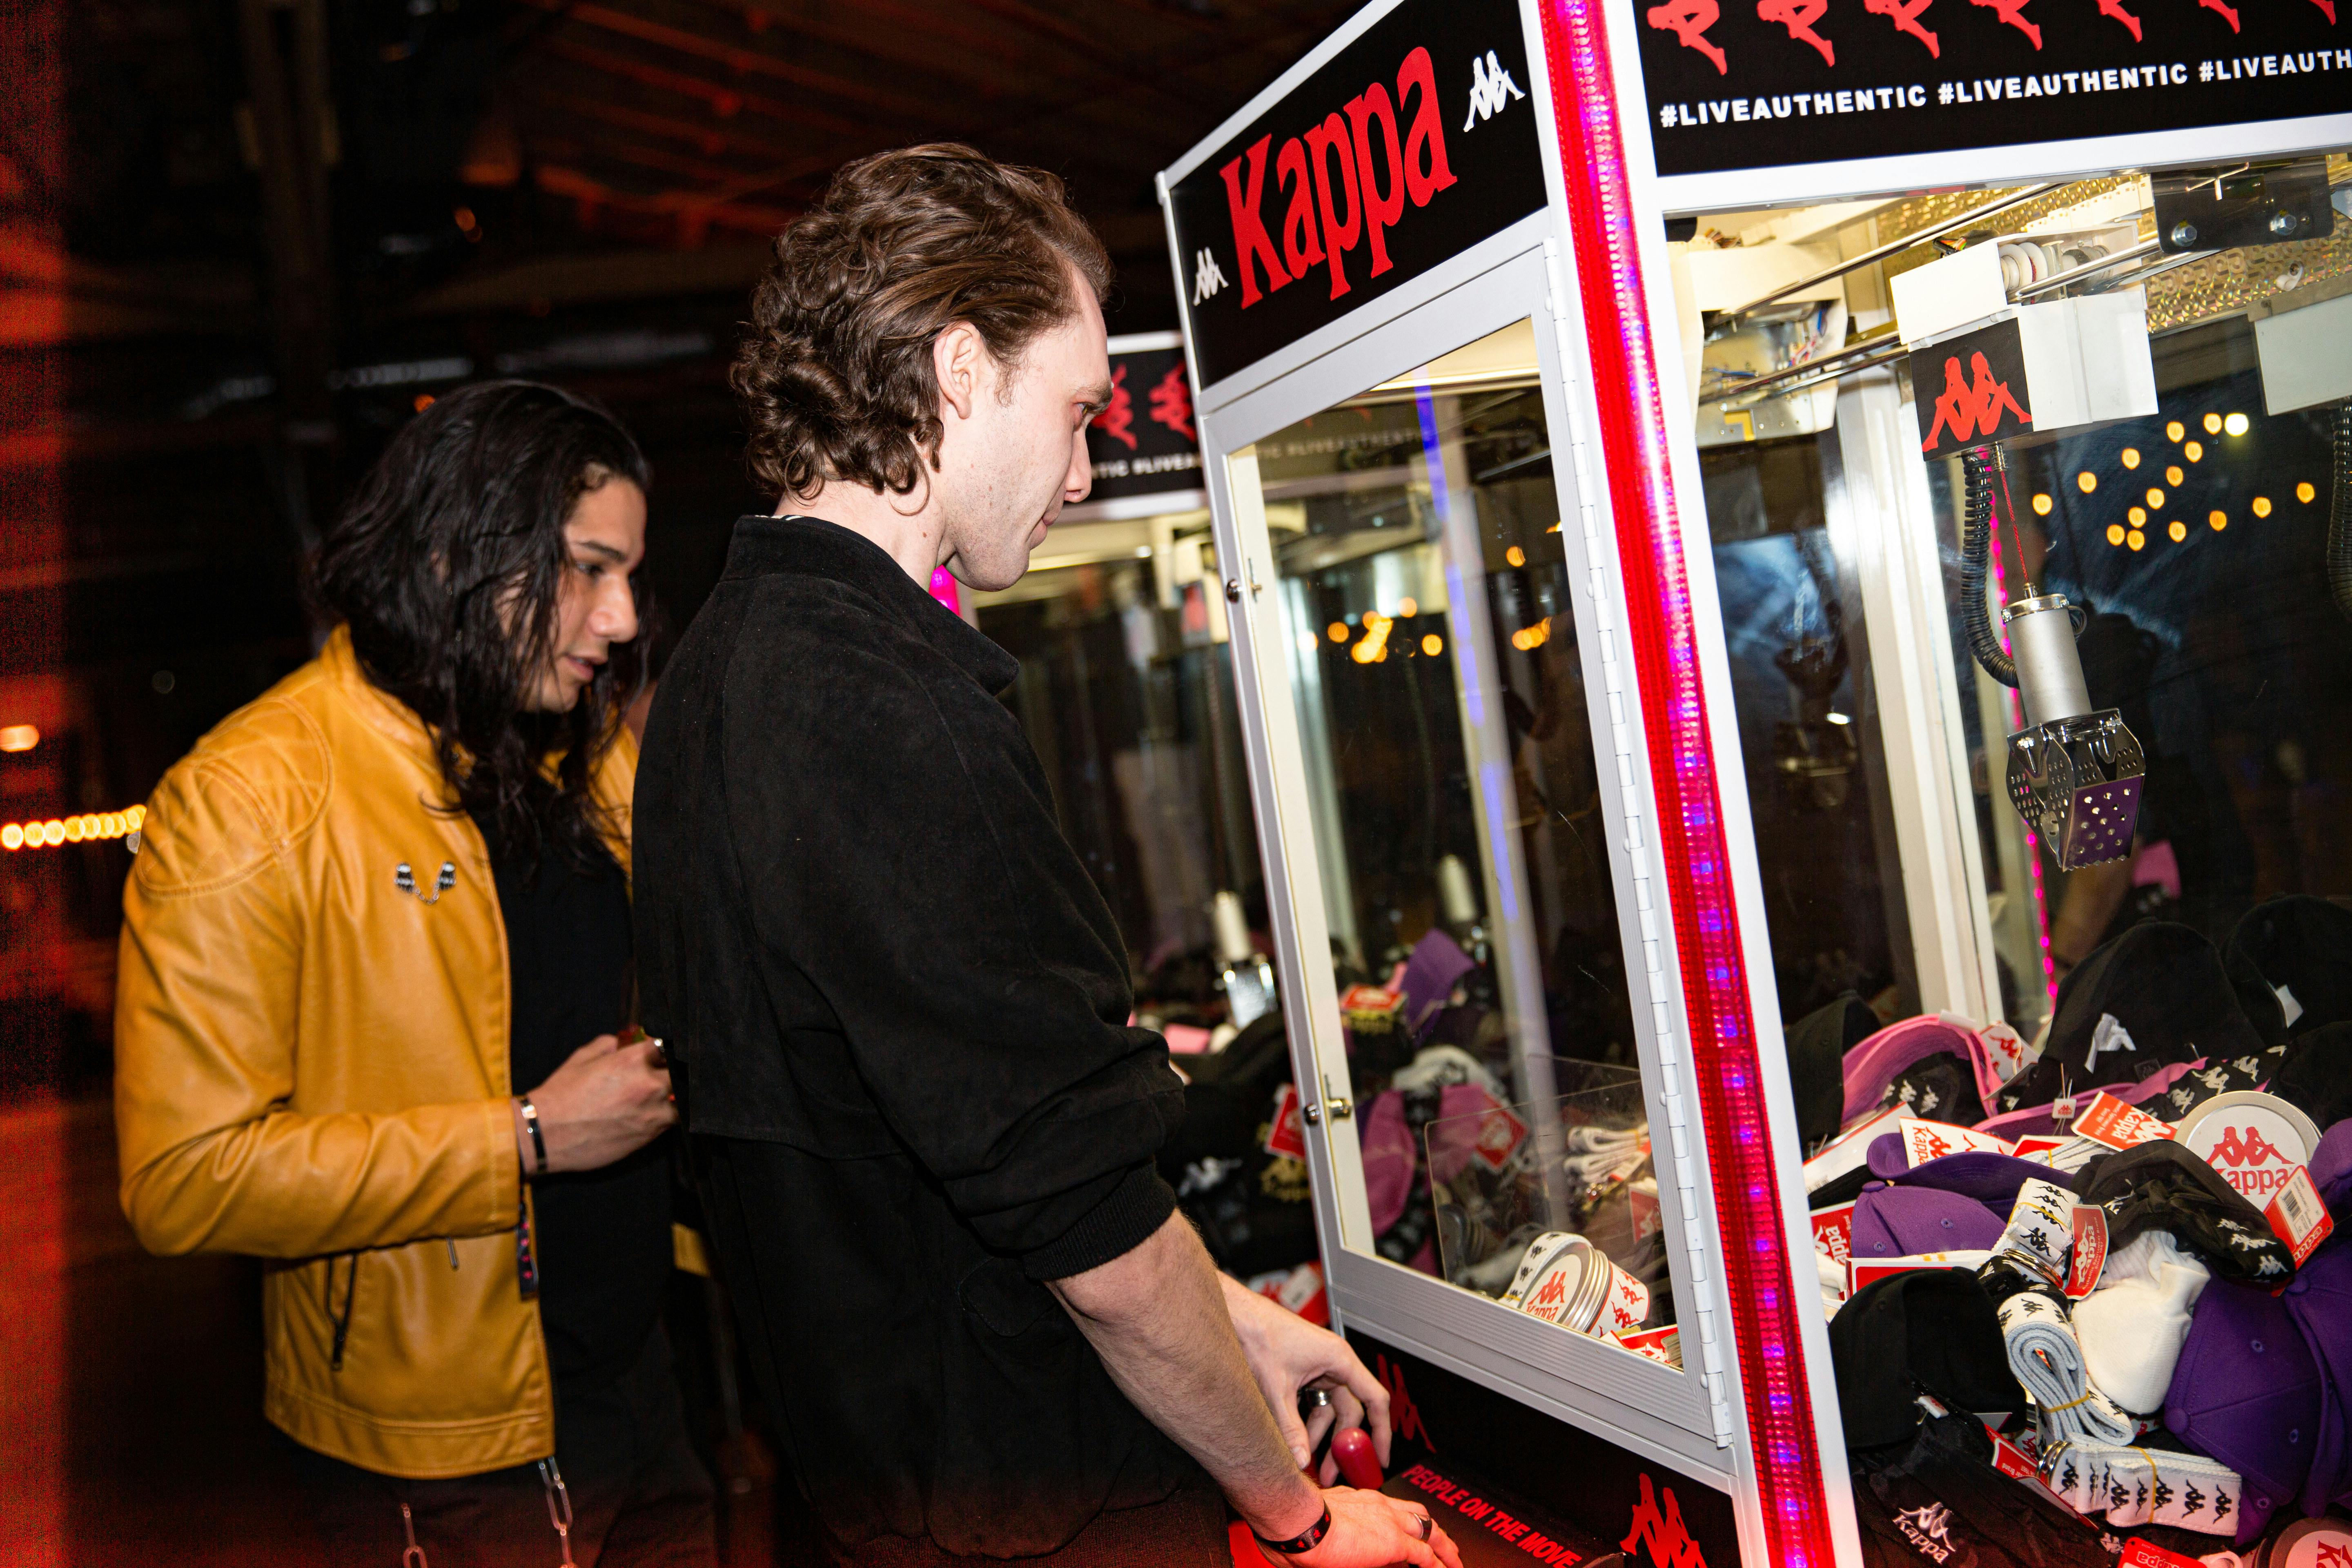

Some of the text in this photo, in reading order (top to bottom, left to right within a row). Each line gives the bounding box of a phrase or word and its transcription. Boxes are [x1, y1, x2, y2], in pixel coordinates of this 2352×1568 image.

[1660, 49, 2352, 128] #LIVEAUTHENTIC #LIVEAUTHENTIC #LIVEAUTH
[1220, 47, 1457, 309] Kappa
[1912, 1127, 1929, 1165] Kappa
[2215, 1168, 2288, 1195] appa
[1825, 1225, 1850, 1266] appa
[2294, 1226, 2323, 1262] appa
[2002, 1463, 2016, 1475] Brand
[1401, 1464, 1582, 1568] PEOPLE ON THE MOVE
[1892, 1514, 1949, 1564] Kappa
